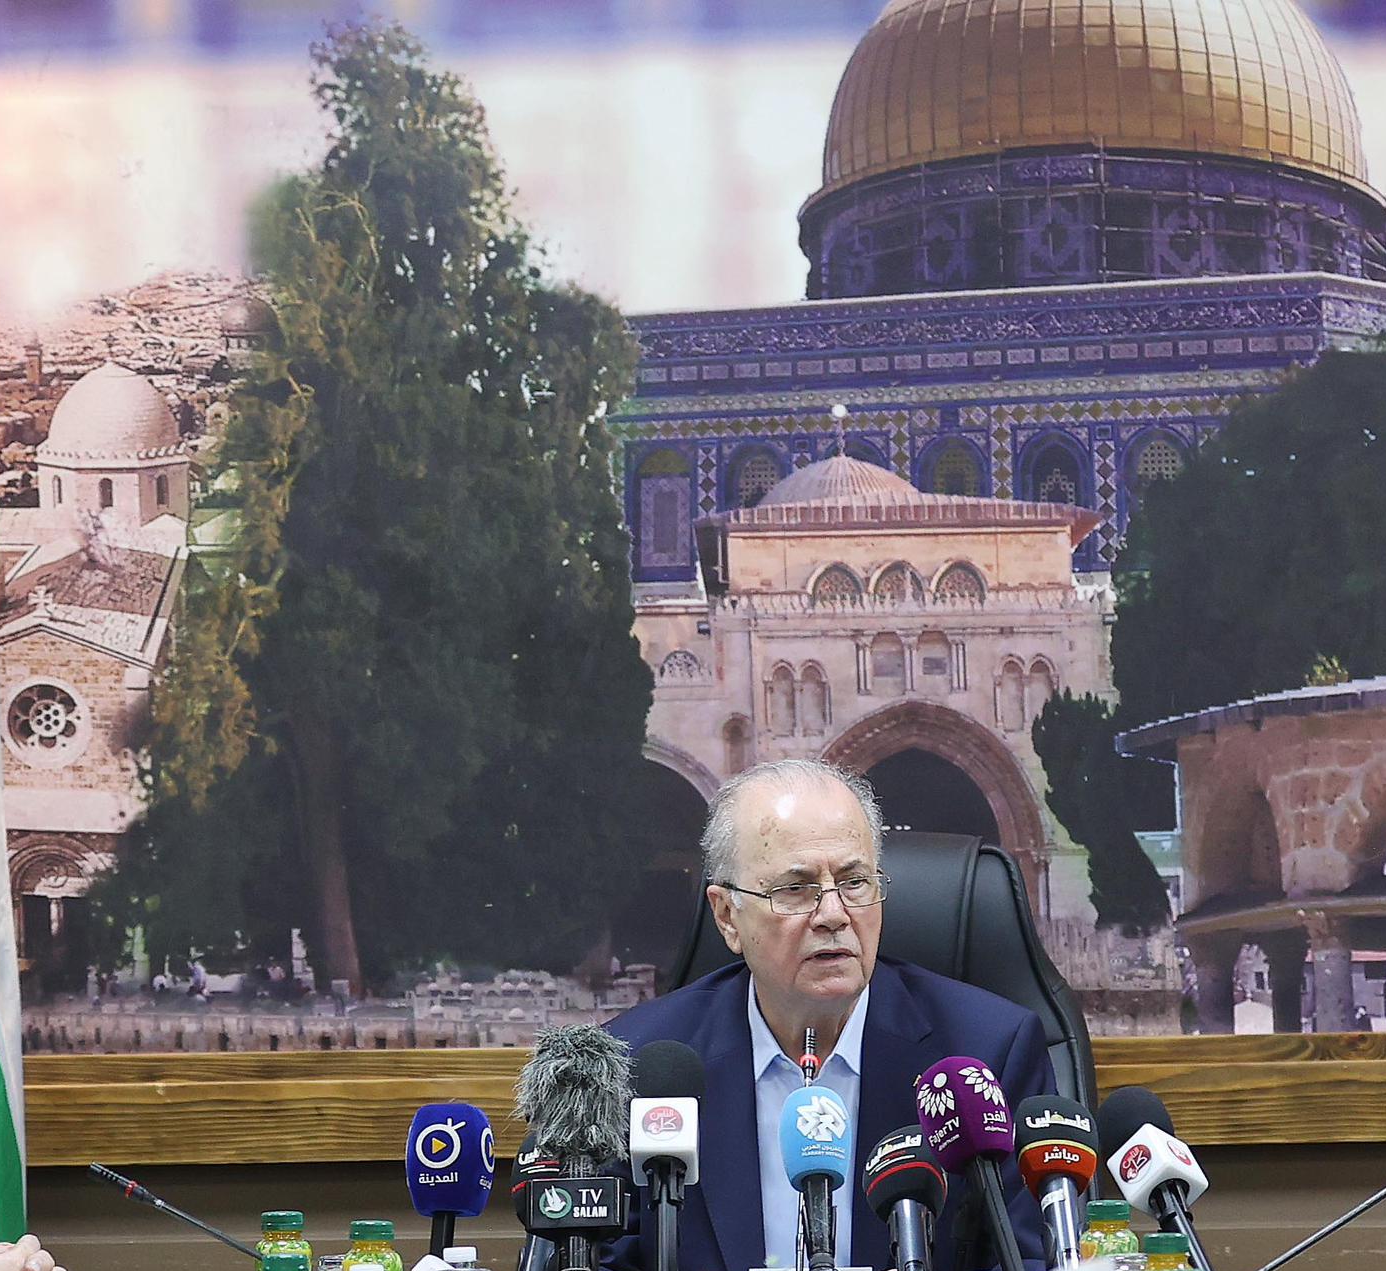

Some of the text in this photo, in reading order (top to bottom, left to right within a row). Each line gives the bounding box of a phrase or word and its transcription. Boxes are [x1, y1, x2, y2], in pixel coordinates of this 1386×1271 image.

[983, 1110, 1007, 1124] الفجر
[1025, 1110, 1091, 1133] فلسطين
[928, 1117, 960, 1147] FajerTV
[1043, 1146, 1080, 1163] مباشر
[418, 1171, 459, 1187] المدينة
[577, 1188, 604, 1205] TV
[573, 1206, 608, 1219] SALAM
